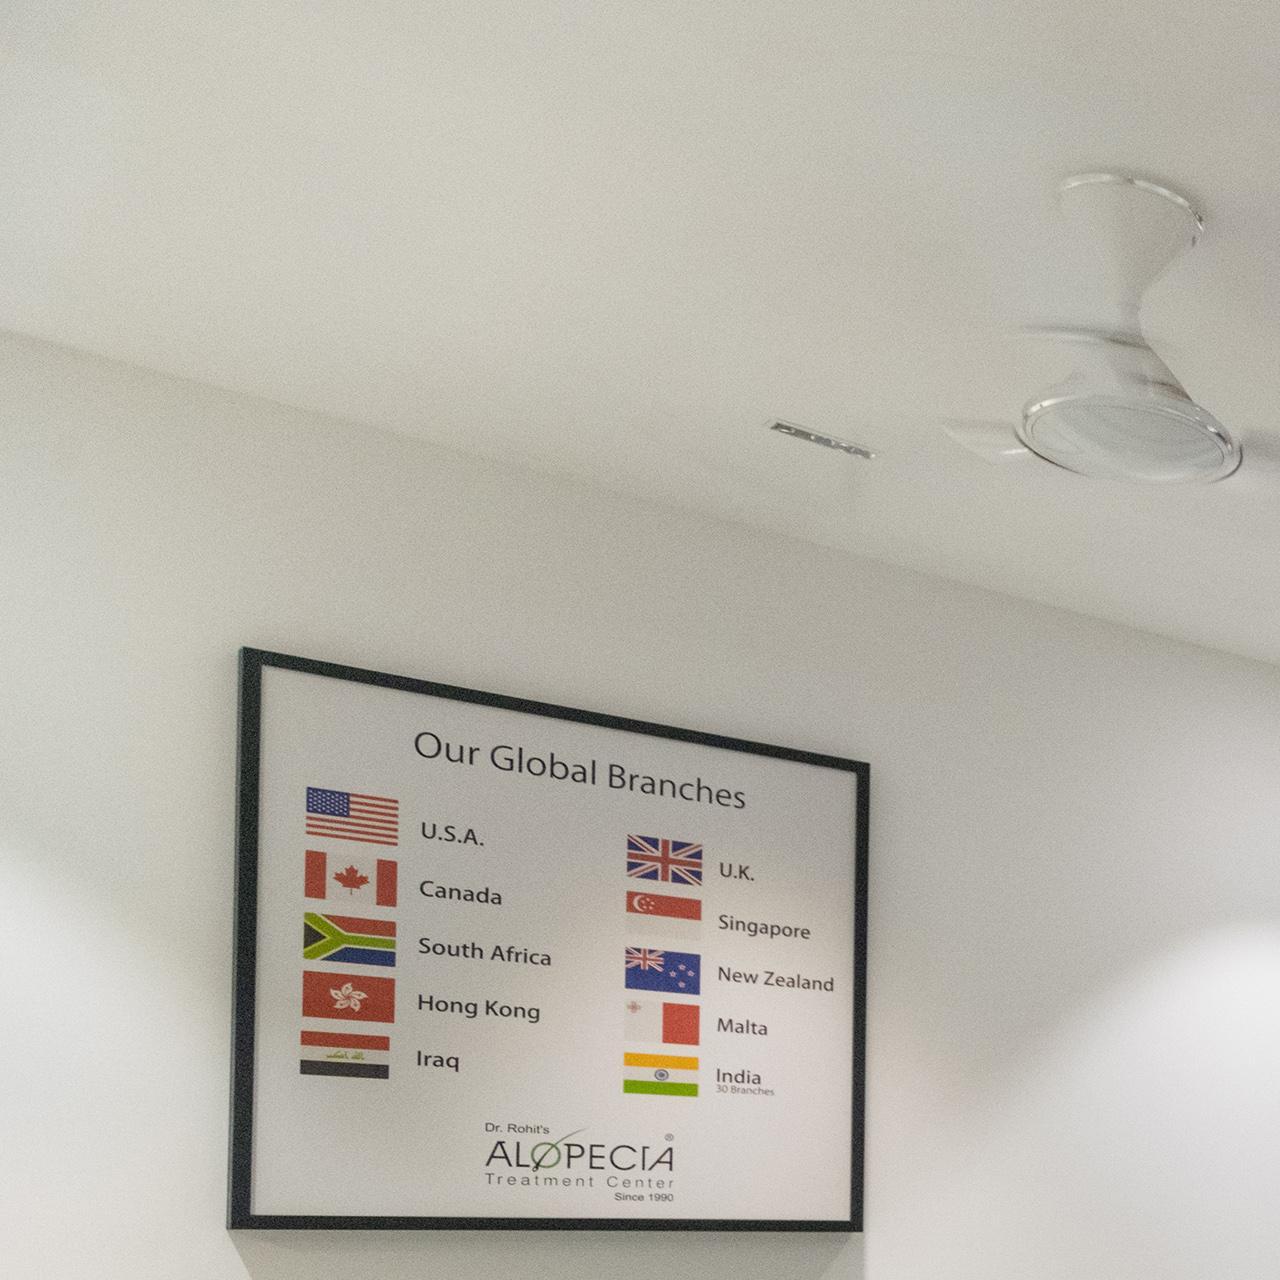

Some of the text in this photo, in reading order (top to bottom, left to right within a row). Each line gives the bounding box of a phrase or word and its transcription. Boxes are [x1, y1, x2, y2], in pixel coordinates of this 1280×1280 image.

[414, 731, 746, 809] Our Global Branches
[421, 822, 485, 846] U.S.A.
[719, 862, 755, 881] U.K.
[419, 880, 502, 905] Canada
[718, 914, 811, 940] Singapore
[418, 937, 552, 966] South Africa
[718, 966, 835, 992] New Zealand
[418, 994, 540, 1024] Hong Kong
[717, 1017, 768, 1036] Malta
[417, 1050, 459, 1073] Iraq
[716, 1068, 762, 1085] India
[716, 1084, 775, 1096] 30 Branches
[485, 1122, 550, 1134] Dr. Rohit's
[485, 1141, 674, 1172] ALOPECIA
[485, 1173, 674, 1189] Treatment Center
[614, 1192, 674, 1202] Since 1990
